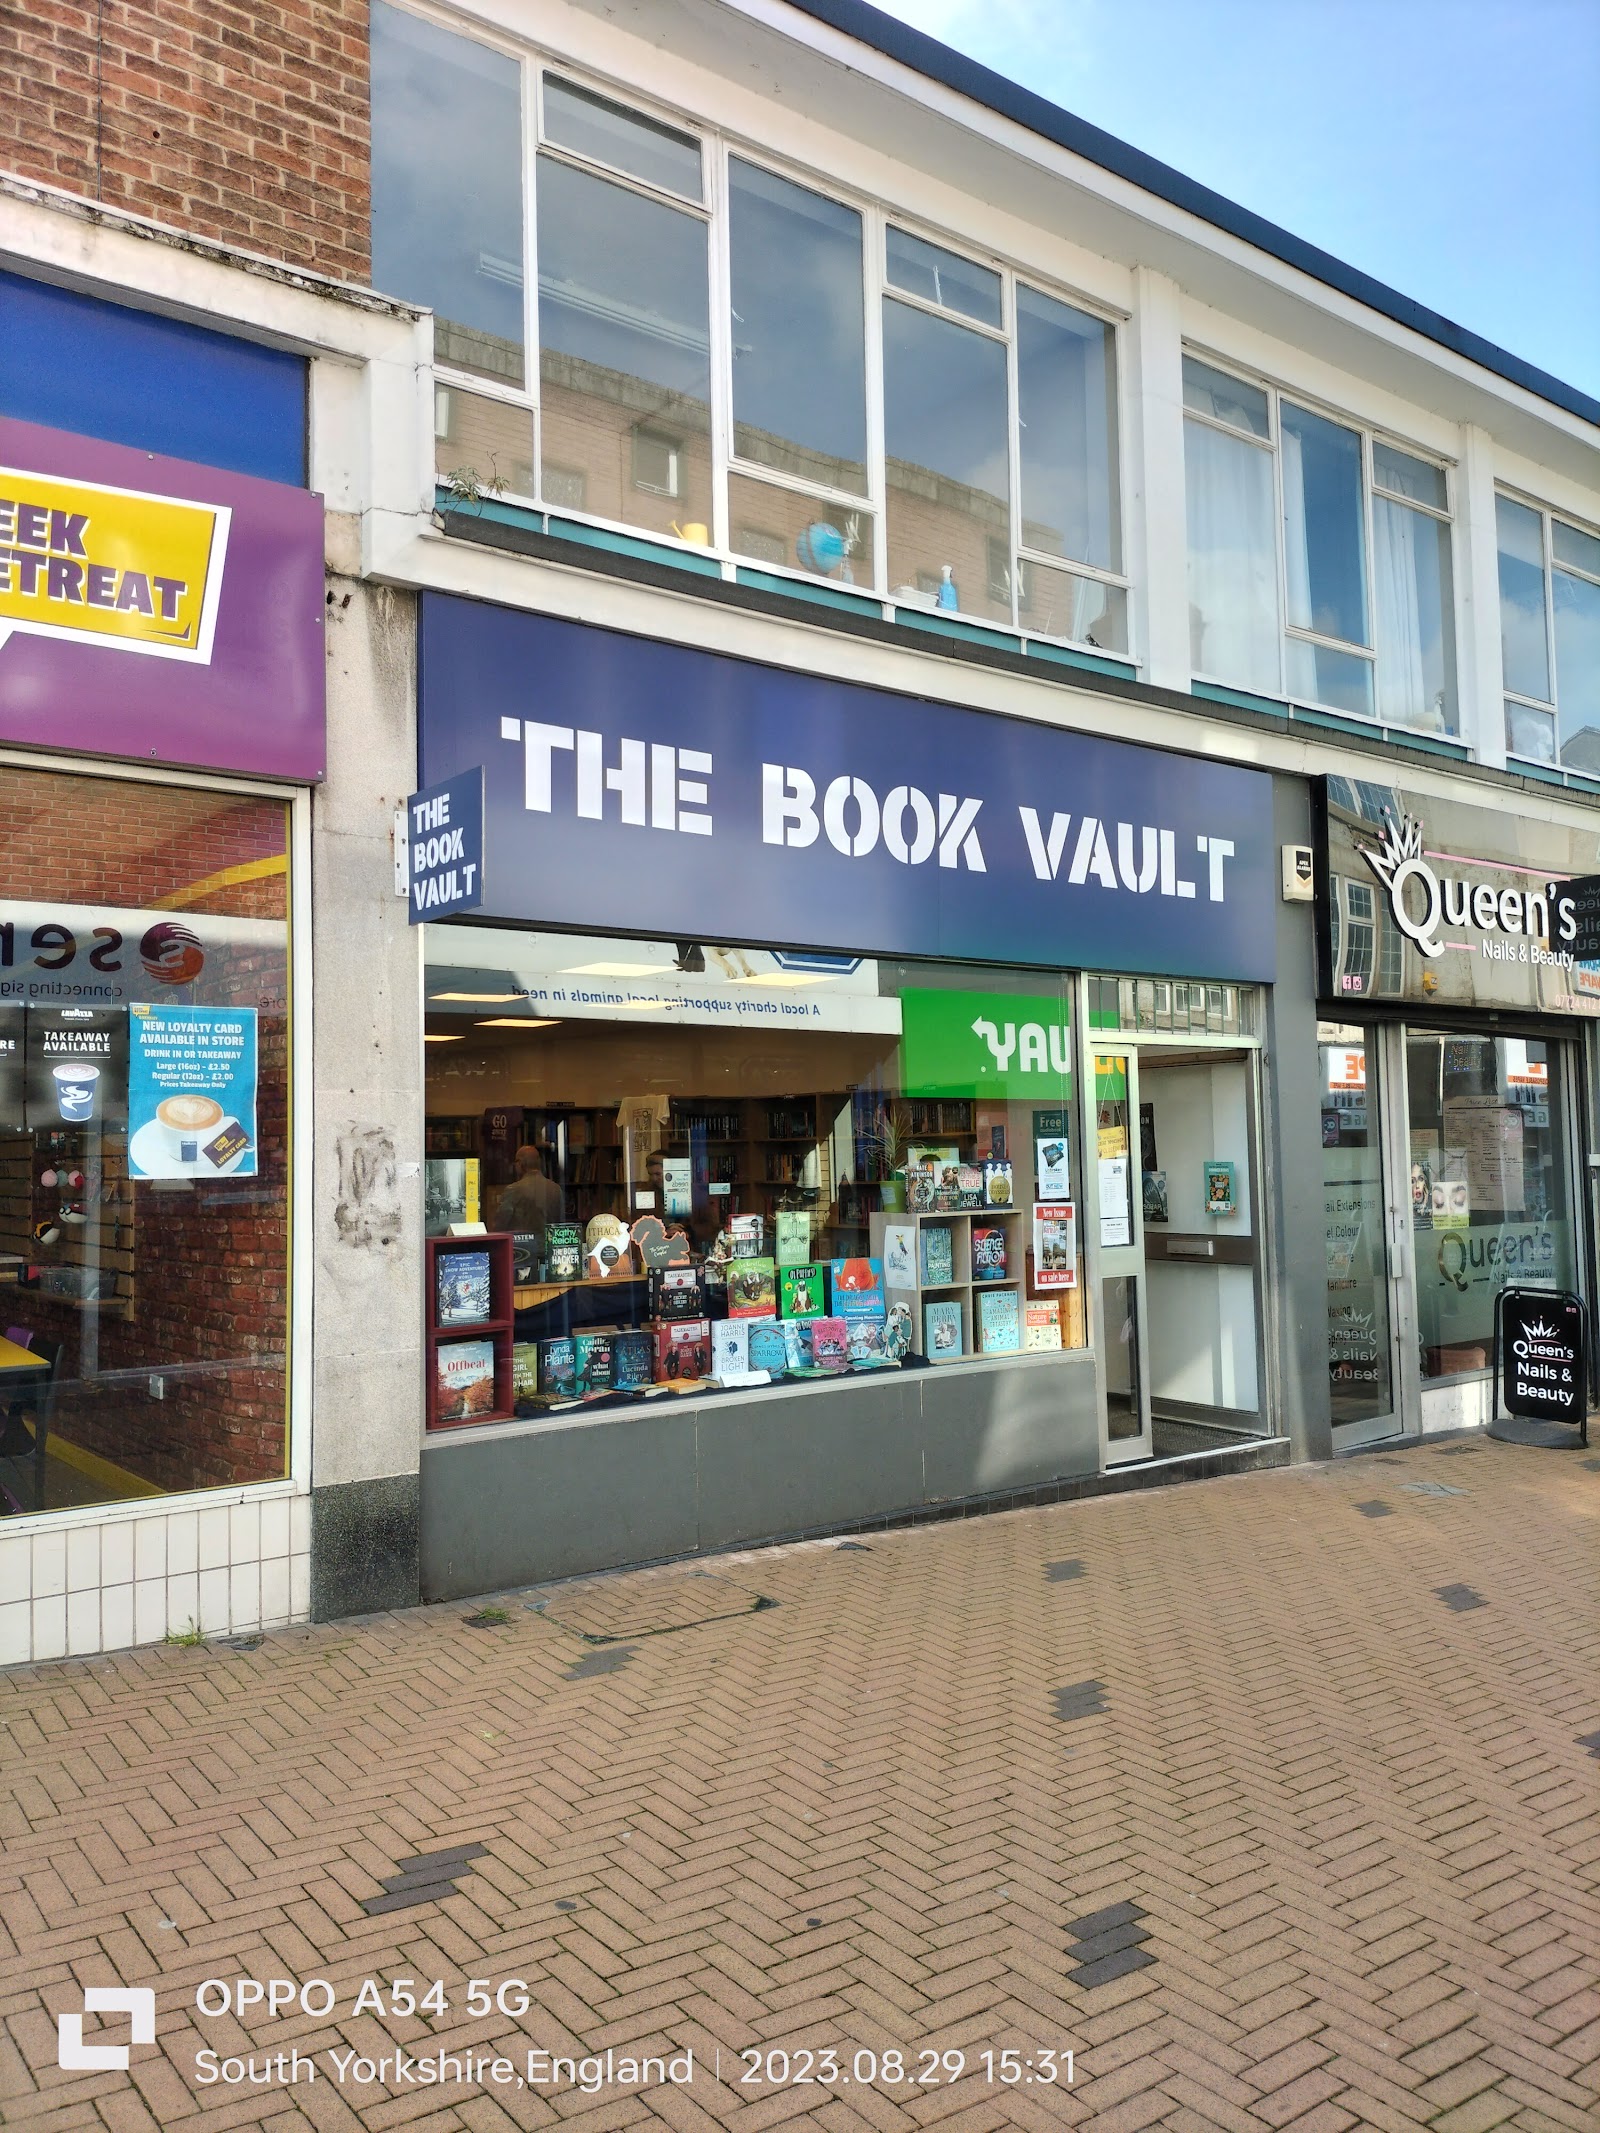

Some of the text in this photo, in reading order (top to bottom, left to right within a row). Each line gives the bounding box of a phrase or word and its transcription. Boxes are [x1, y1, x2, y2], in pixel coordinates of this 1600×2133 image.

[413, 793, 450, 834] THE
[501, 716, 1235, 903] THE BOOK VAULT
[414, 827, 465, 875] BOOK
[414, 863, 476, 912] VAULT
[1390, 857, 1577, 958] Queen's
[1482, 939, 1575, 972] Nails & Beauty
[142, 1020, 243, 1034] NEW LOYALTY CARD
[44, 1031, 110, 1042] TAKEAWAY
[139, 1033, 245, 1046] AVAILABLE IN STORE
[43, 1041, 111, 1052] AVAILABLE
[144, 1049, 242, 1059] DRINK IN OR TAKEAWAY
[156, 1062, 176, 1071] Large
[177, 1063, 201, 1071] (16oz)
[208, 1063, 230, 1071] £2.50
[152, 1072, 180, 1081] Regular
[182, 1072, 204, 1081] (12oz)
[211, 1073, 234, 1081] £2.00
[492, 1114, 507, 1129] GO
[1040, 1116, 1061, 1128] Free
[217, 1148, 236, 1165] LOYALTY
[235, 1137, 247, 1149] CARD
[960, 1179, 980, 1188] TRUE
[1337, 1198, 1376, 1212] Extensions
[1042, 1208, 1066, 1217] New Issue
[554, 1229, 577, 1237] Kathy
[588, 1227, 620, 1236] ITHACA
[1335, 1226, 1360, 1238] Colour
[552, 1236, 579, 1245] Reichs
[974, 1237, 1003, 1252] SCIENCE
[563, 1247, 579, 1255] BONE
[552, 1255, 580, 1265] HACKER
[976, 1250, 1005, 1265] FICTION
[1438, 1226, 1552, 1292] Queen's
[1048, 1273, 1058, 1281] sale
[1060, 1272, 1070, 1281] here
[932, 1307, 954, 1315] MARY
[931, 1315, 956, 1324] BERRY
[1028, 1313, 1047, 1321] Nature
[721, 1323, 745, 1331] JOANNE
[549, 1344, 570, 1355] Lynda
[750, 1349, 784, 1357] SPARROW
[1513, 1340, 1575, 1359] Queen's
[544, 1353, 575, 1366] Plante
[721, 1355, 745, 1363] BROKEN
[447, 1358, 486, 1372] Offbeat
[621, 1364, 649, 1373] Lucinda
[721, 1362, 744, 1371] LIGHT
[626, 1372, 644, 1381] Riley
[1517, 1361, 1573, 1382] Nails &
[1516, 1381, 1575, 1406] Beauty
